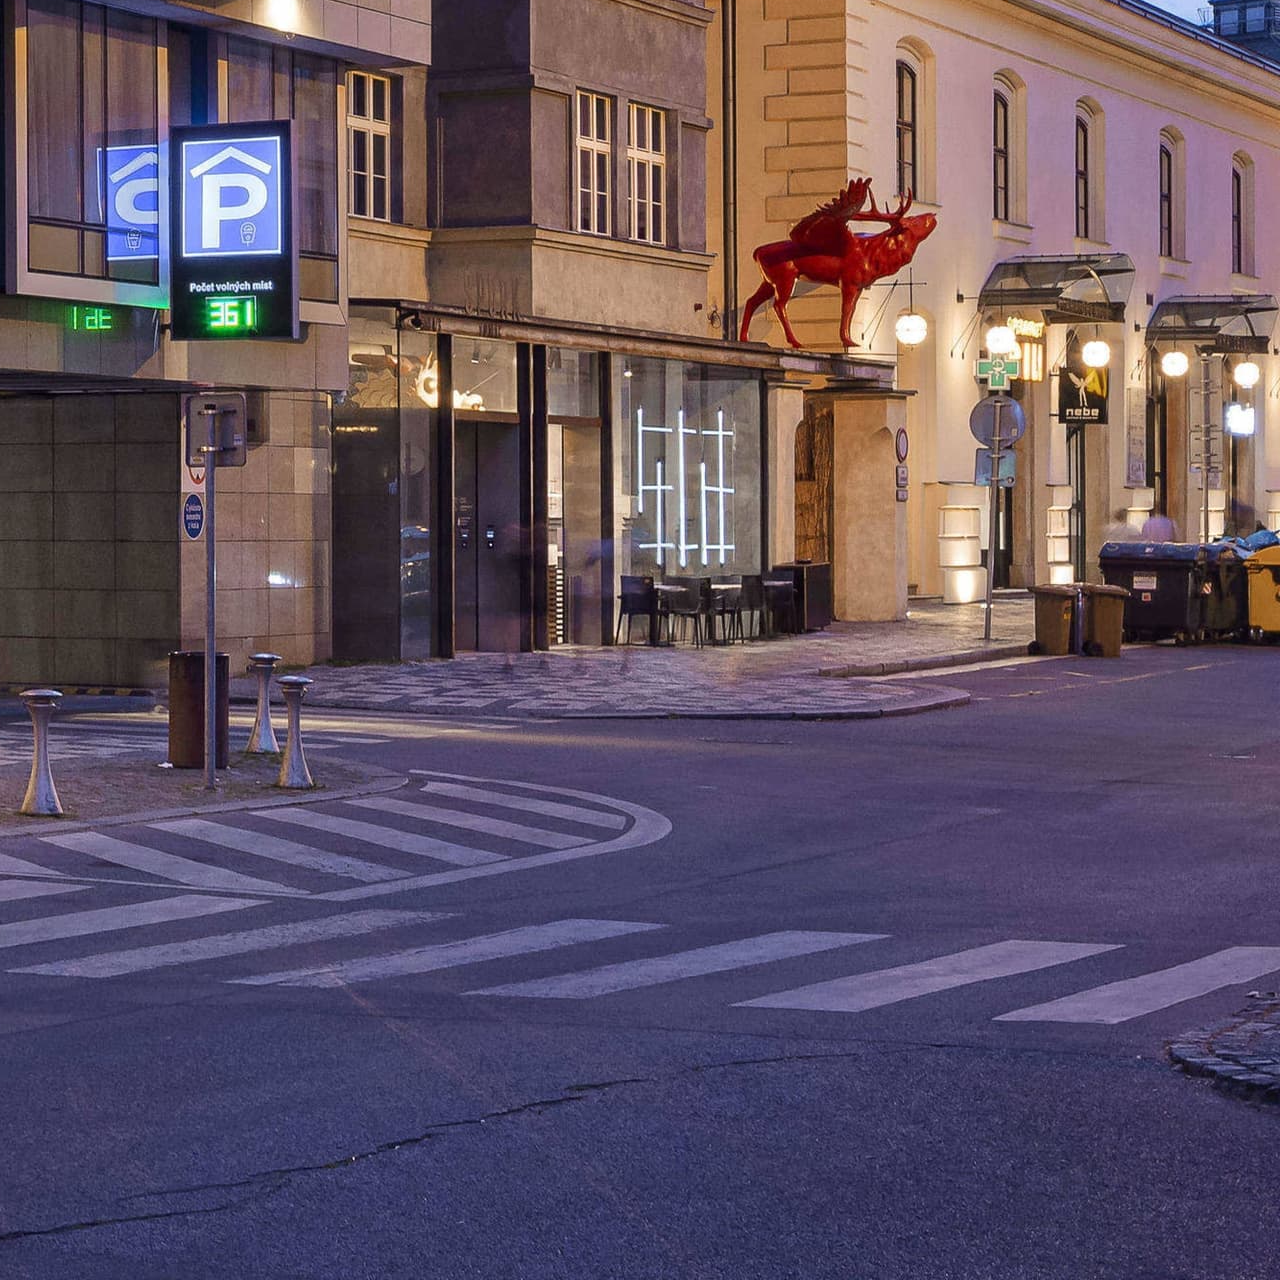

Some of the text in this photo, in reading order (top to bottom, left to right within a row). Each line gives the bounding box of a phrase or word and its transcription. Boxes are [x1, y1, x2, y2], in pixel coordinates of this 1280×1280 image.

[201, 173, 268, 249] P
[189, 282, 214, 293] Počet
[215, 281, 251, 294] volných
[209, 300, 253, 328] 361
[1065, 407, 1100, 416] nebe
